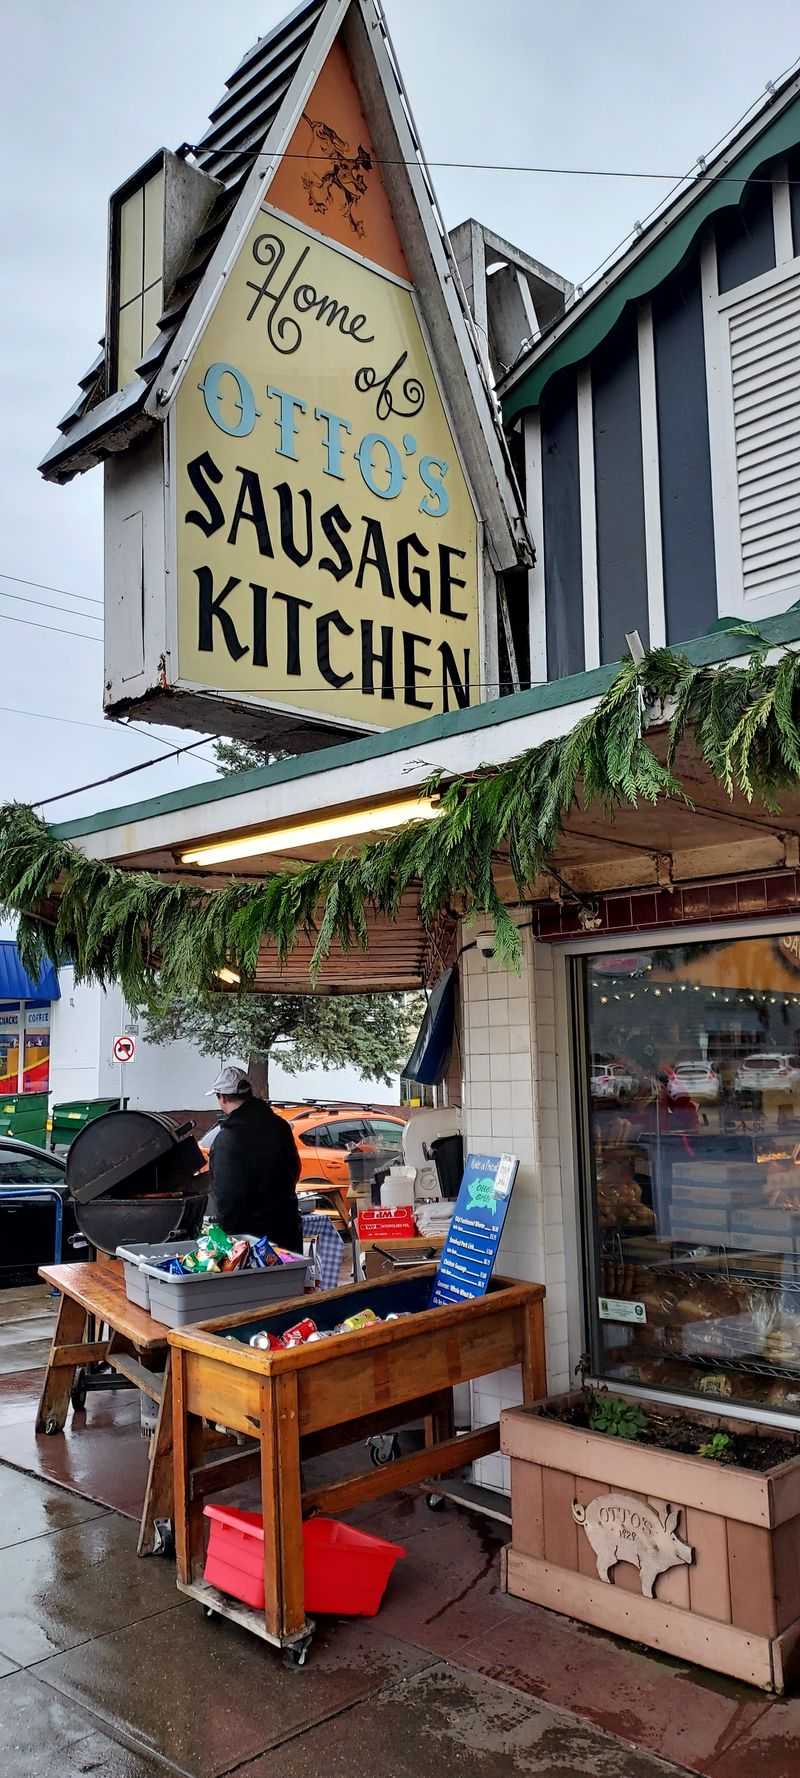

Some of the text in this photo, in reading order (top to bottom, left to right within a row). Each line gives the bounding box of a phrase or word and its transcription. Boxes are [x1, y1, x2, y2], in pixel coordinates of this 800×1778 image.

[246, 233, 375, 354] Home
[197, 362, 449, 517] OTTO'S
[354, 350, 425, 420] of
[184, 450, 468, 621] SAUSAGE
[192, 565, 471, 714] KITCHEN
[28, 1012, 49, 1023] COFFEE
[600, 1507, 653, 1535] OTTO'S
